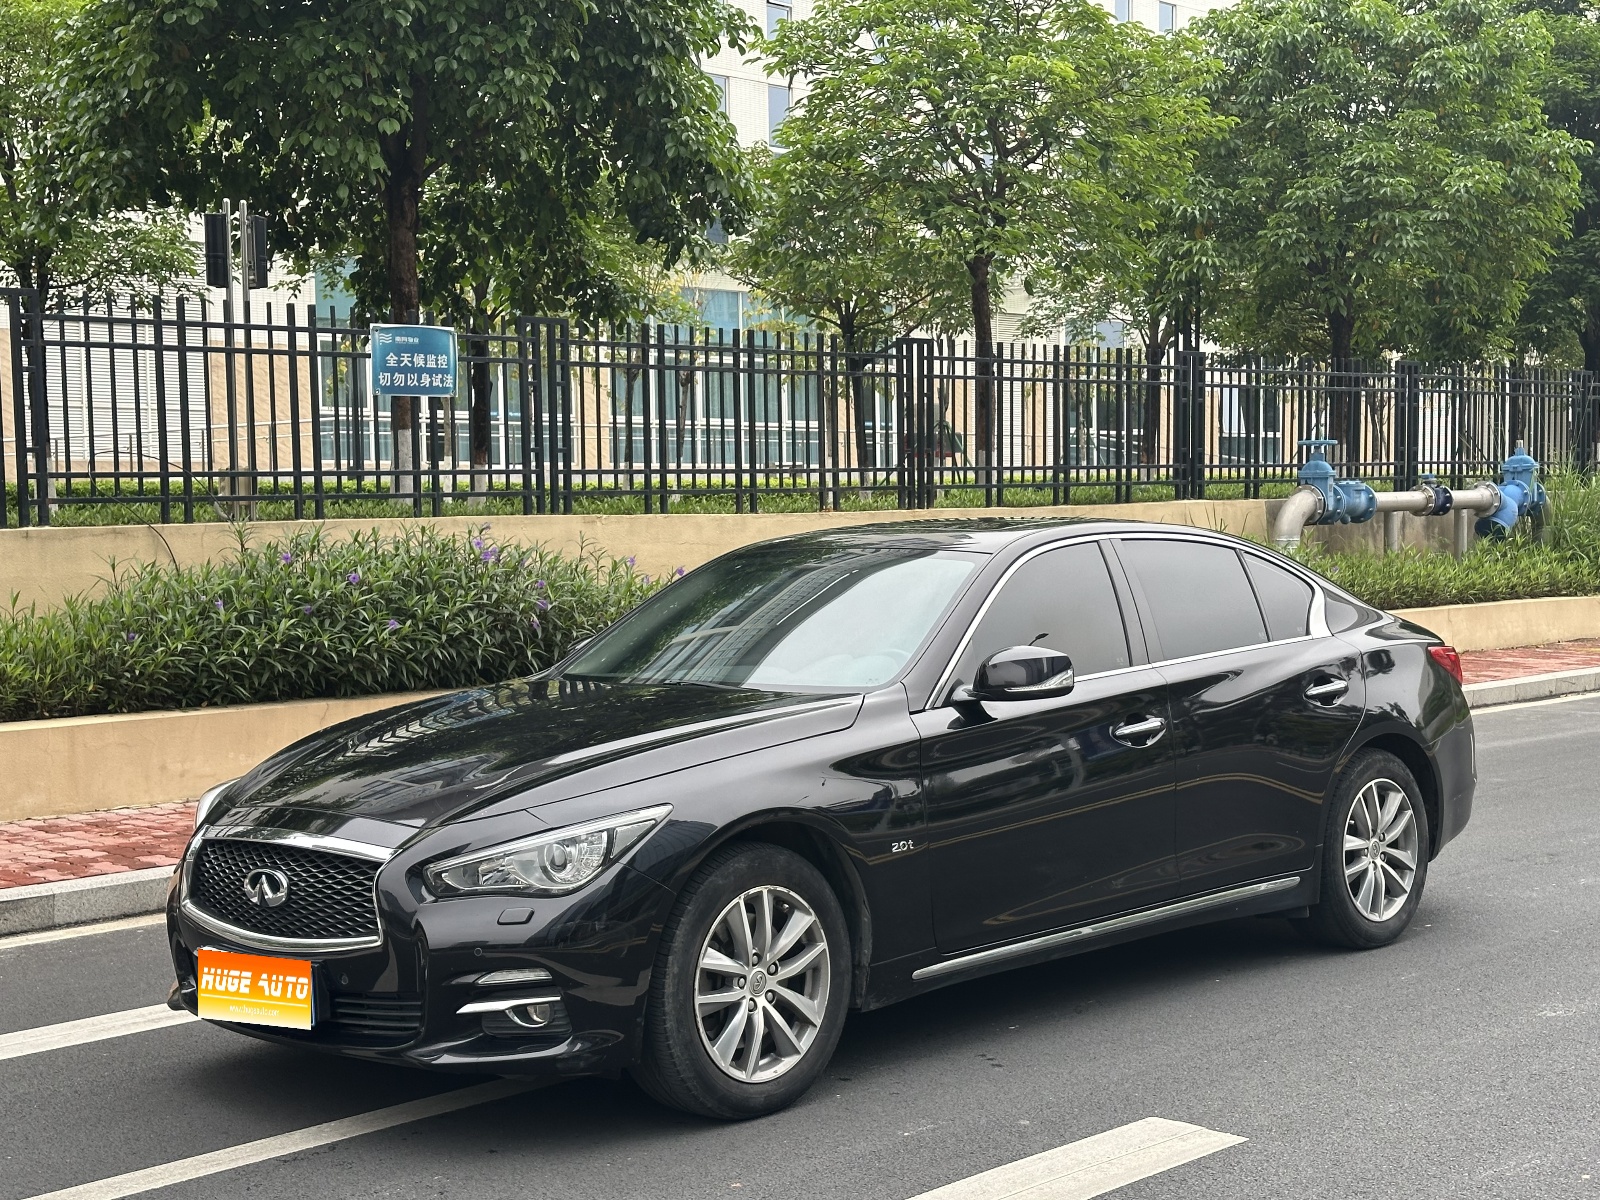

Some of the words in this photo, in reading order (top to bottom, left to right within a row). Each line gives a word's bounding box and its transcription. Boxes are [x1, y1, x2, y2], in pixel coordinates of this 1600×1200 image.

[385, 352, 448, 368] 全天候监控
[378, 372, 453, 388] 切勿以身试法
